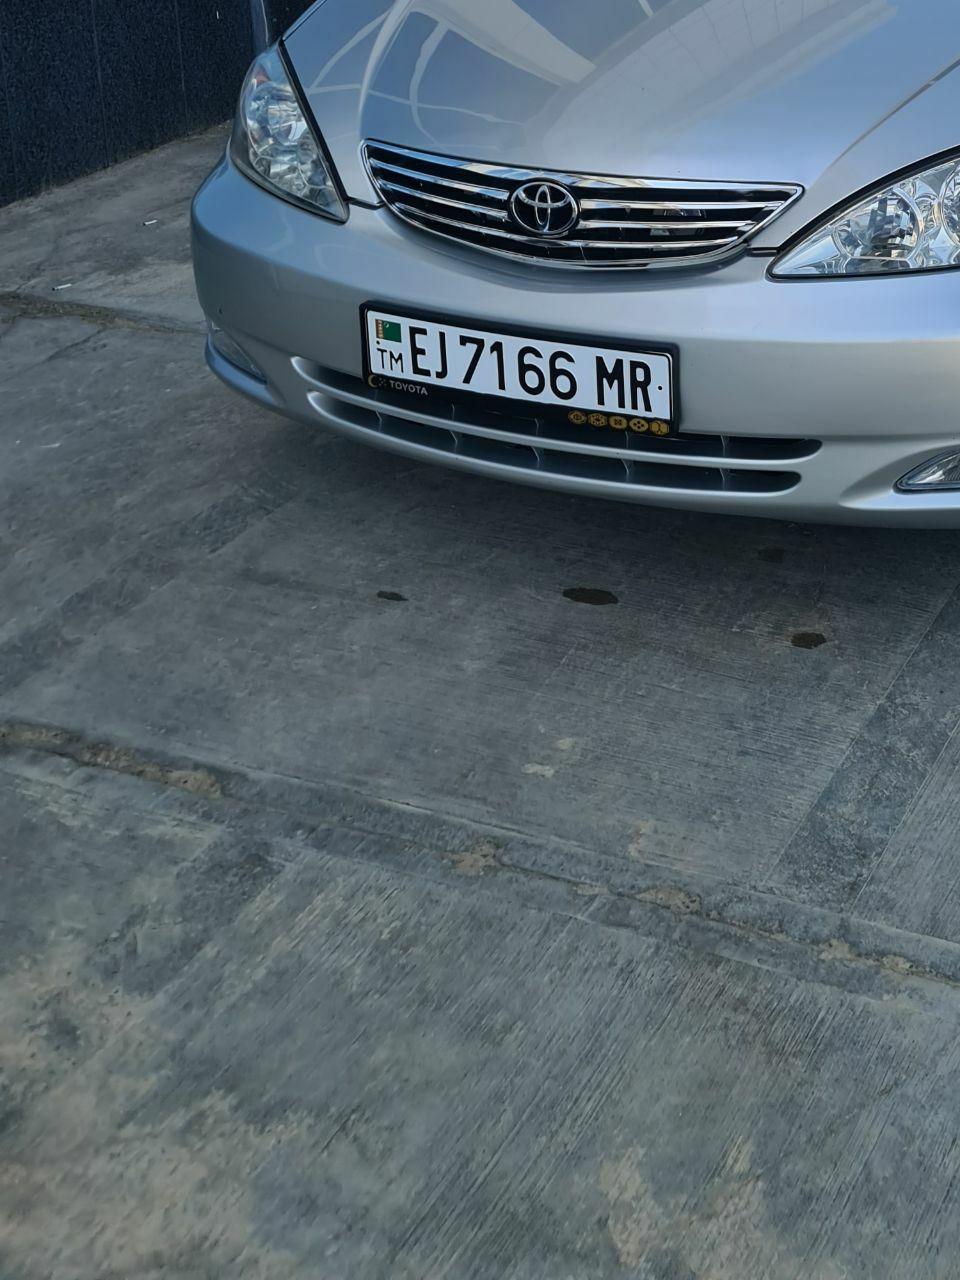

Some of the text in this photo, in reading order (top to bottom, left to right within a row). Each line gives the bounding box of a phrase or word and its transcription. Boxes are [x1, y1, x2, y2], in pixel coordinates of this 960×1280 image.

[376, 347, 404, 373] TM
[390, 380, 428, 396] TOYOTA
[596, 355, 652, 412] MR
